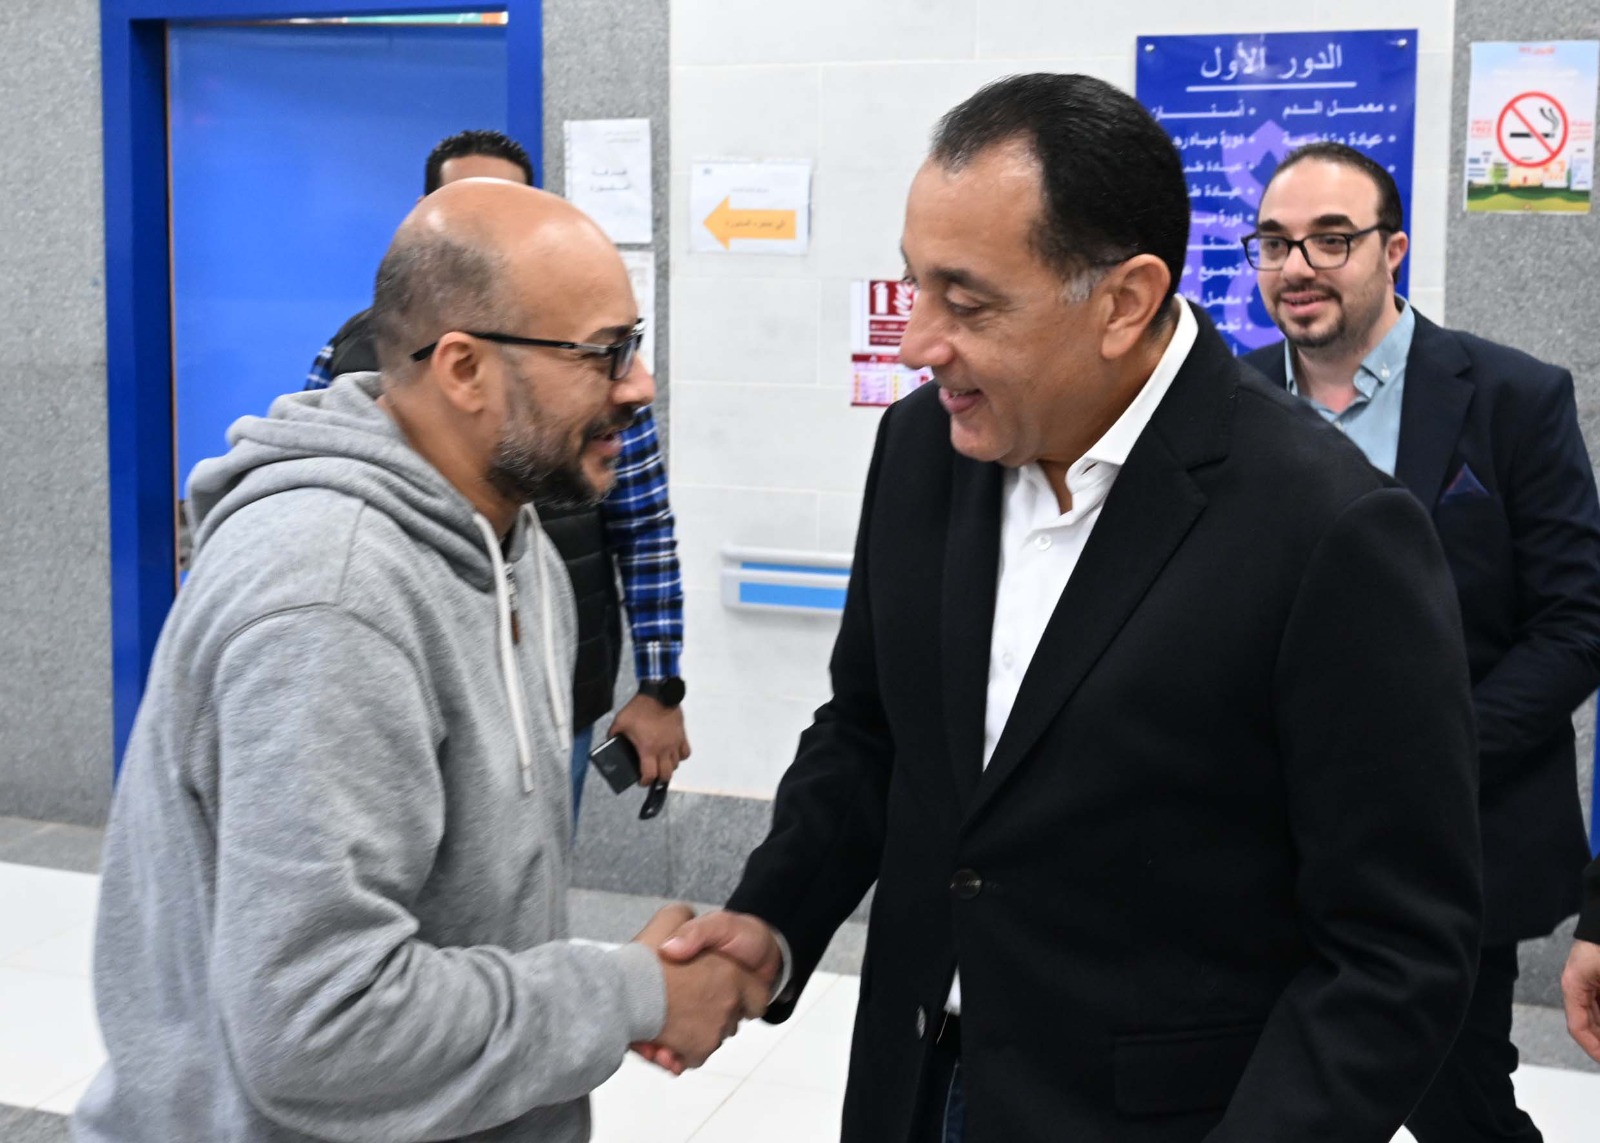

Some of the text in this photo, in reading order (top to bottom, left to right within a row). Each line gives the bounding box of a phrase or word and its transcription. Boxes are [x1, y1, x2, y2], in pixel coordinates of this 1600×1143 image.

[1200, 41, 1342, 81] الدور الأول
[1282, 99, 1384, 120] معمل الدم
